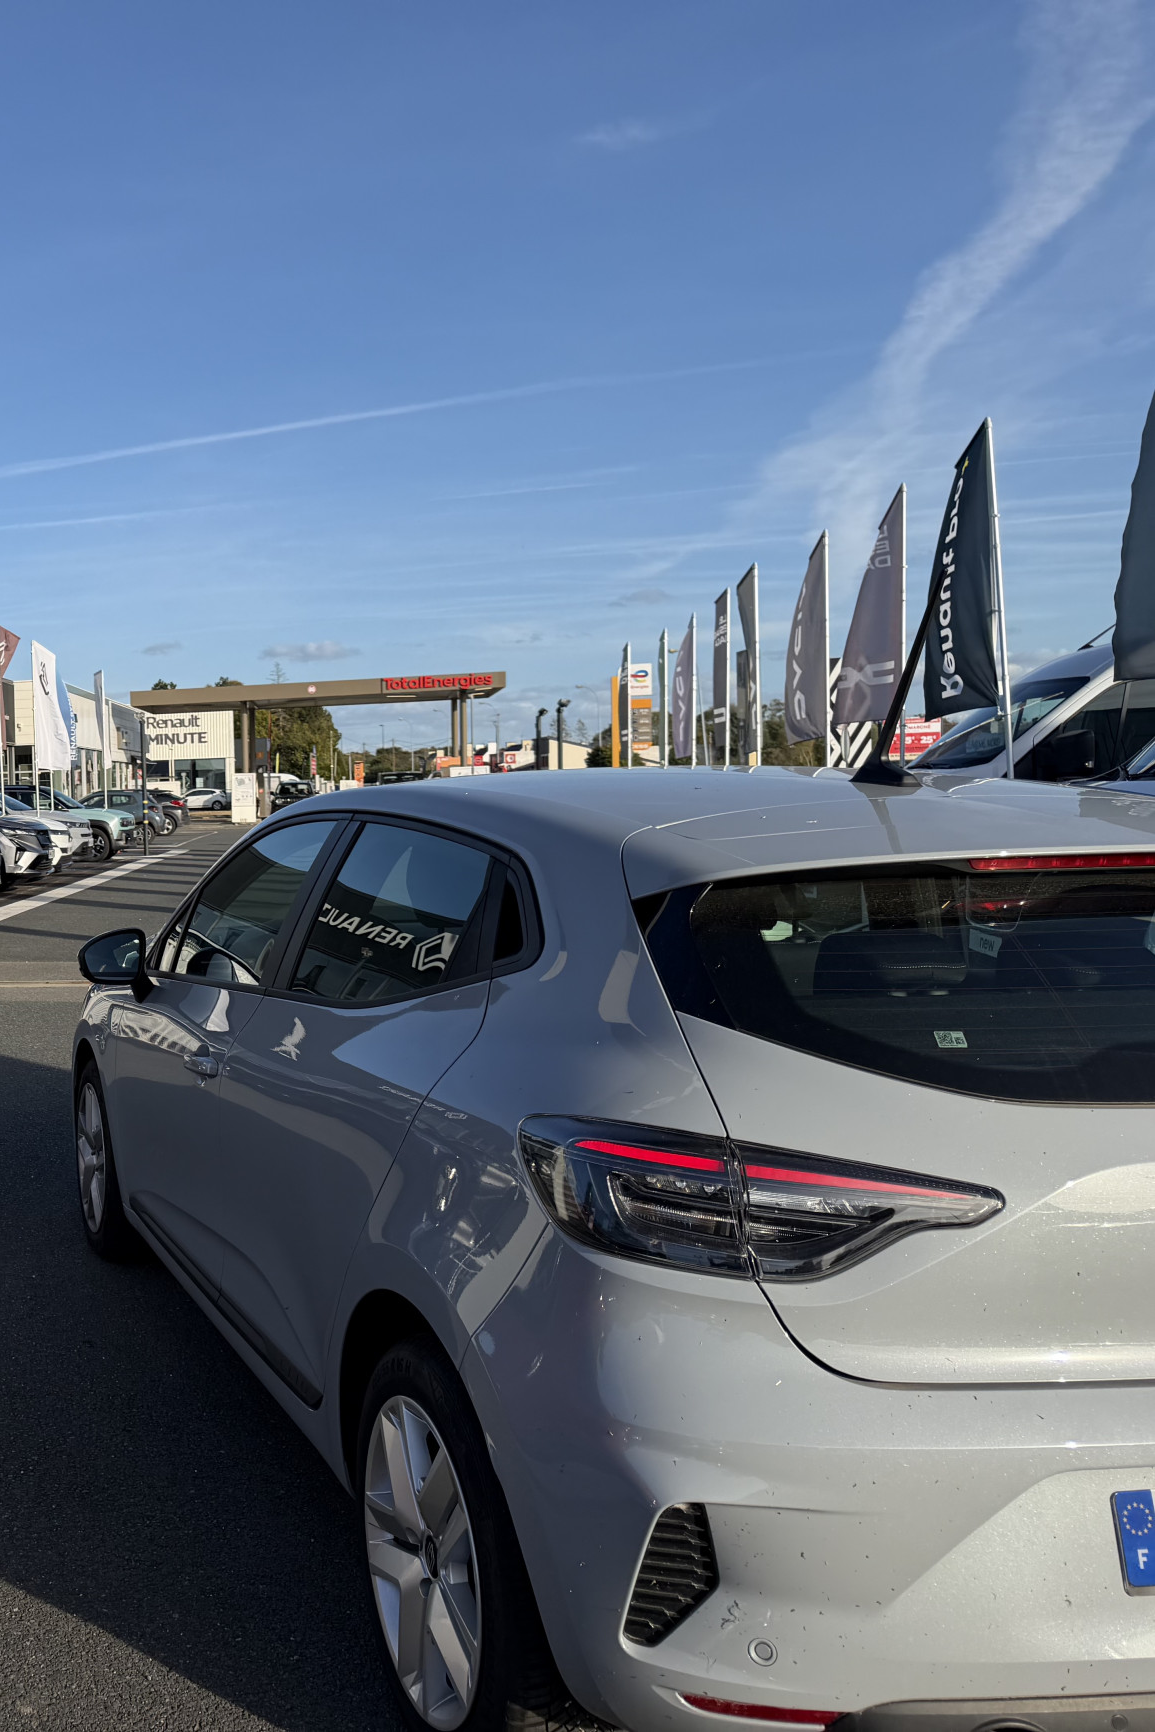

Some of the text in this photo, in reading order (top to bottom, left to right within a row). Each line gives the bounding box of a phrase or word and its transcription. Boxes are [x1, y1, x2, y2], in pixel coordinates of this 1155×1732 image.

[384, 673, 494, 690] TotalEnergies
[146, 714, 200, 729] Renault
[149, 732, 208, 745] MINUTE
[1137, 1549, 1148, 1569] F
